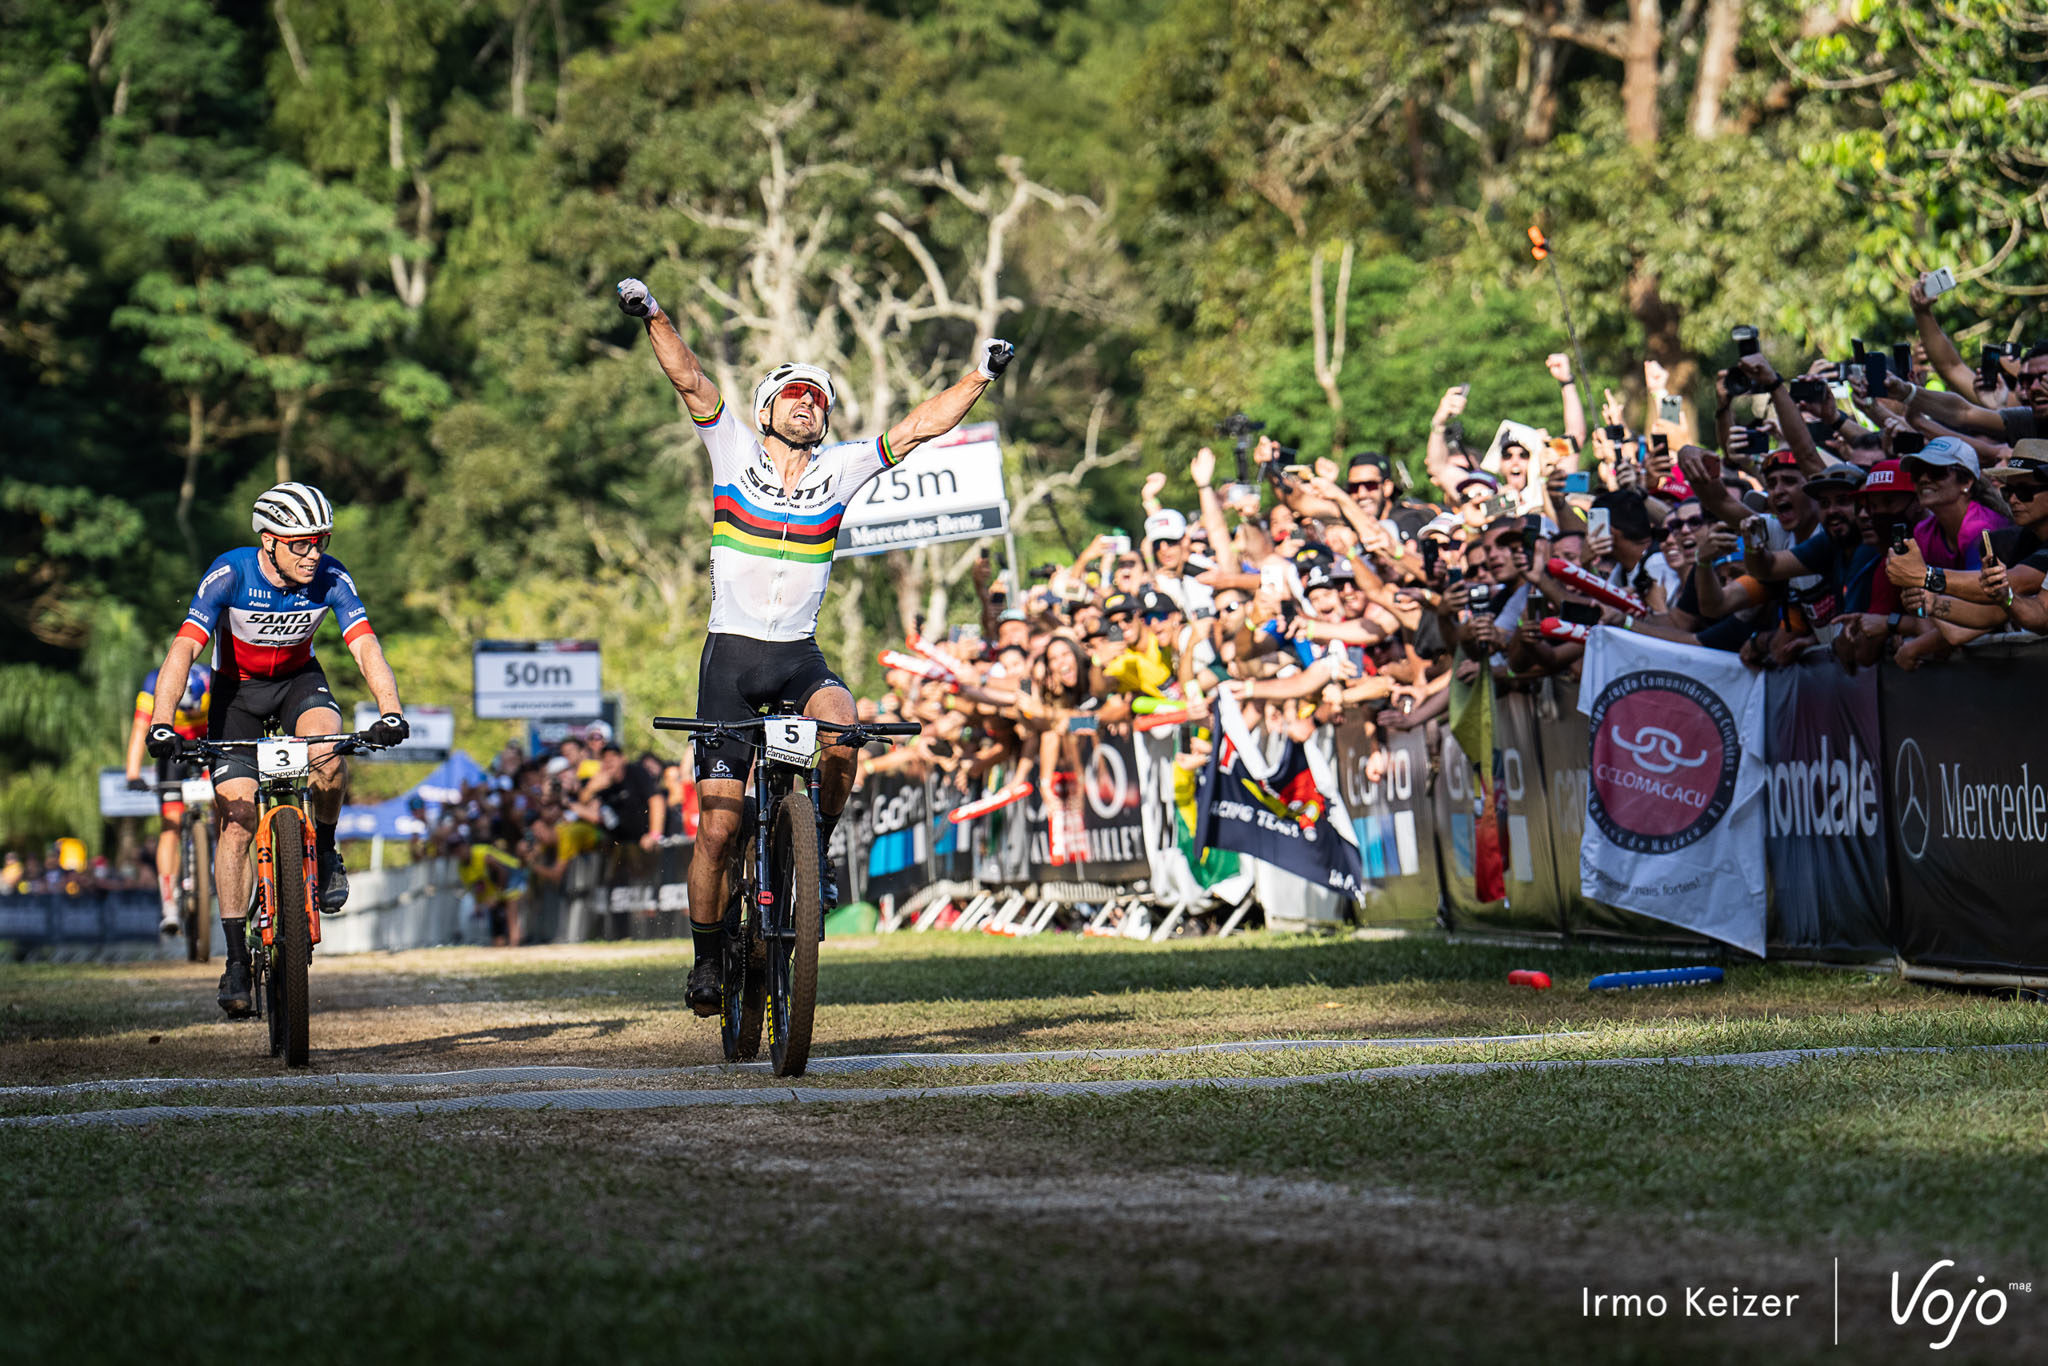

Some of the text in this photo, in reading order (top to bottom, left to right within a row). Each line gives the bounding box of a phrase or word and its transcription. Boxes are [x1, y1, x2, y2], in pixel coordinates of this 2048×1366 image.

[866, 468, 958, 505] 25m
[850, 513, 984, 548] Mercedes-Benz
[245, 612, 313, 625] SANTA
[257, 624, 312, 636] CRUZ
[504, 661, 572, 688] 50m
[784, 724, 800, 744] 5
[275, 749, 291, 767] 3
